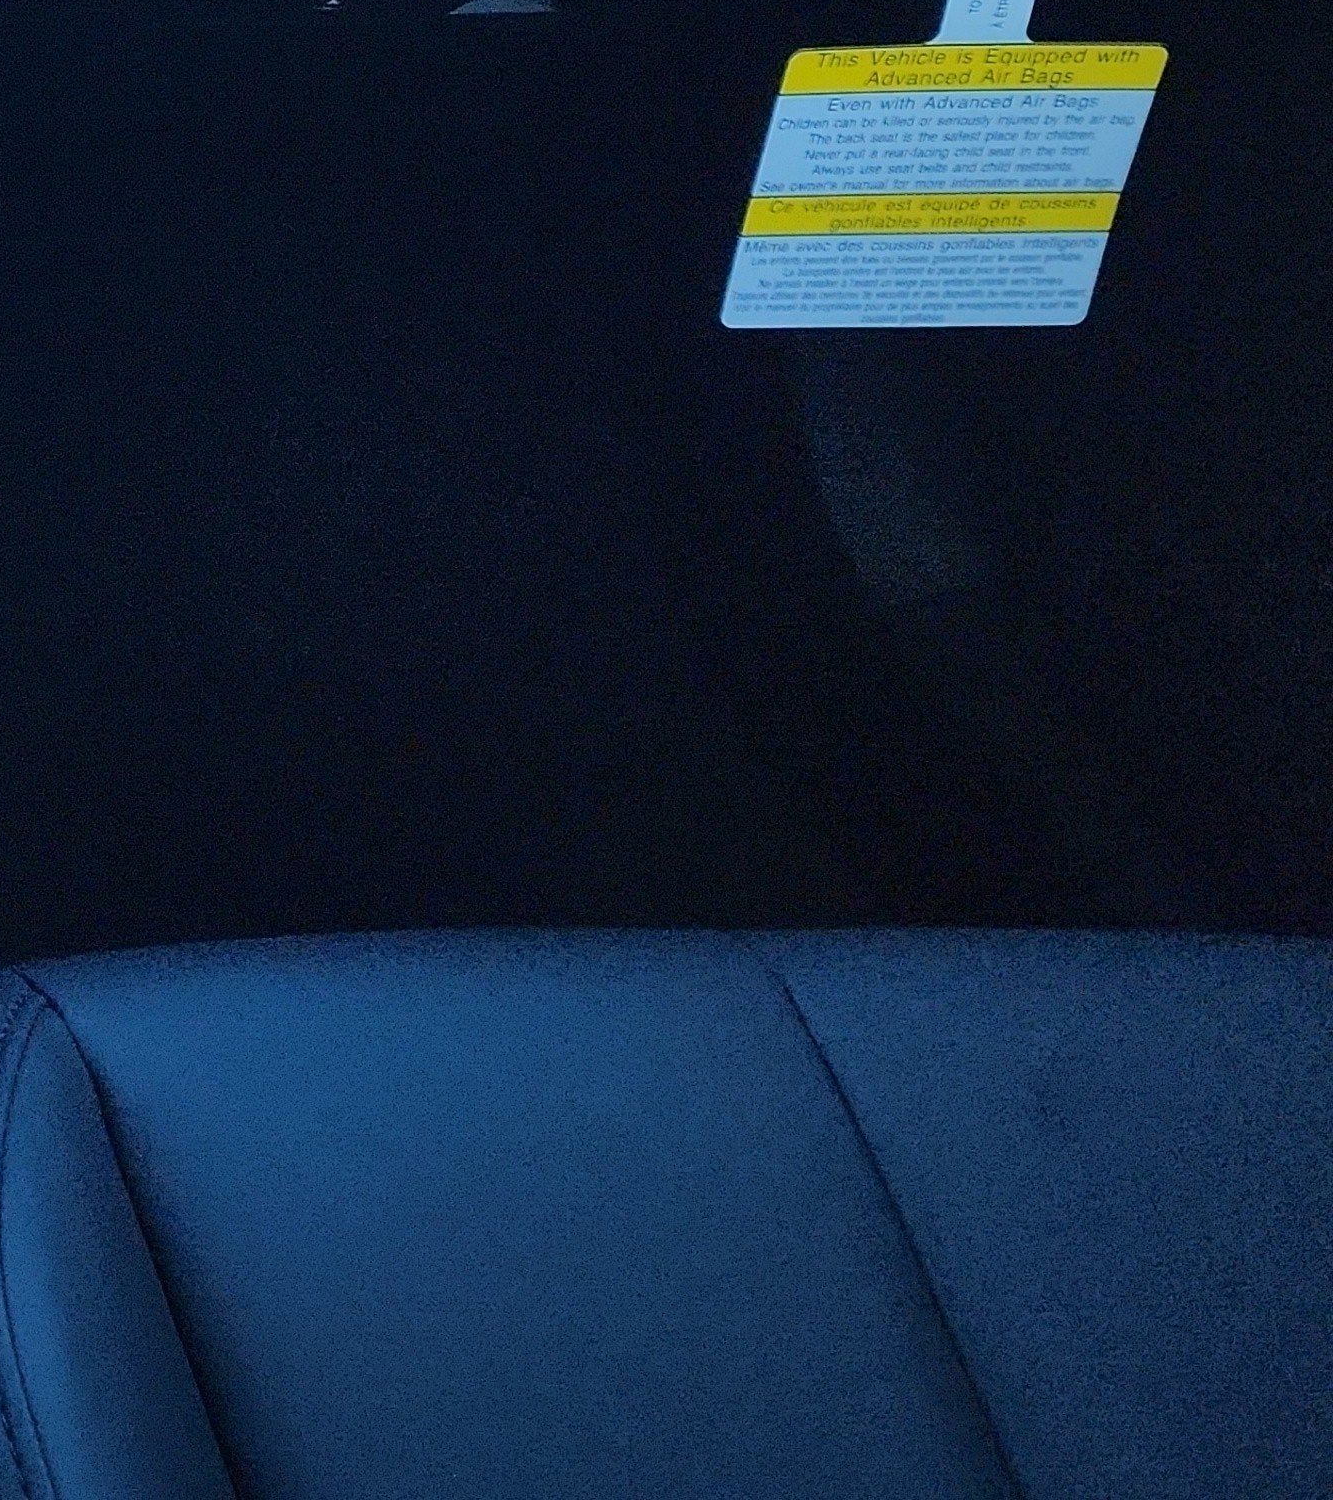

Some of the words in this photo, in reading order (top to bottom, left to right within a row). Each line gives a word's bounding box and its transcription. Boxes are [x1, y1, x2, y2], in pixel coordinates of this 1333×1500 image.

[818, 52, 859, 68] This
[871, 49, 946, 66] Vehicle
[956, 49, 973, 64] is
[985, 48, 1088, 67] Equipped
[1097, 50, 1140, 63] with
[864, 70, 972, 86] Advanced
[982, 69, 1014, 84] Air
[1020, 68, 1075, 88] Bags
[827, 97, 872, 112] Even
[880, 96, 915, 110] with
[923, 95, 1013, 109] Advanced
[1020, 95, 1045, 108] Air
[1053, 94, 1100, 111] Bags
